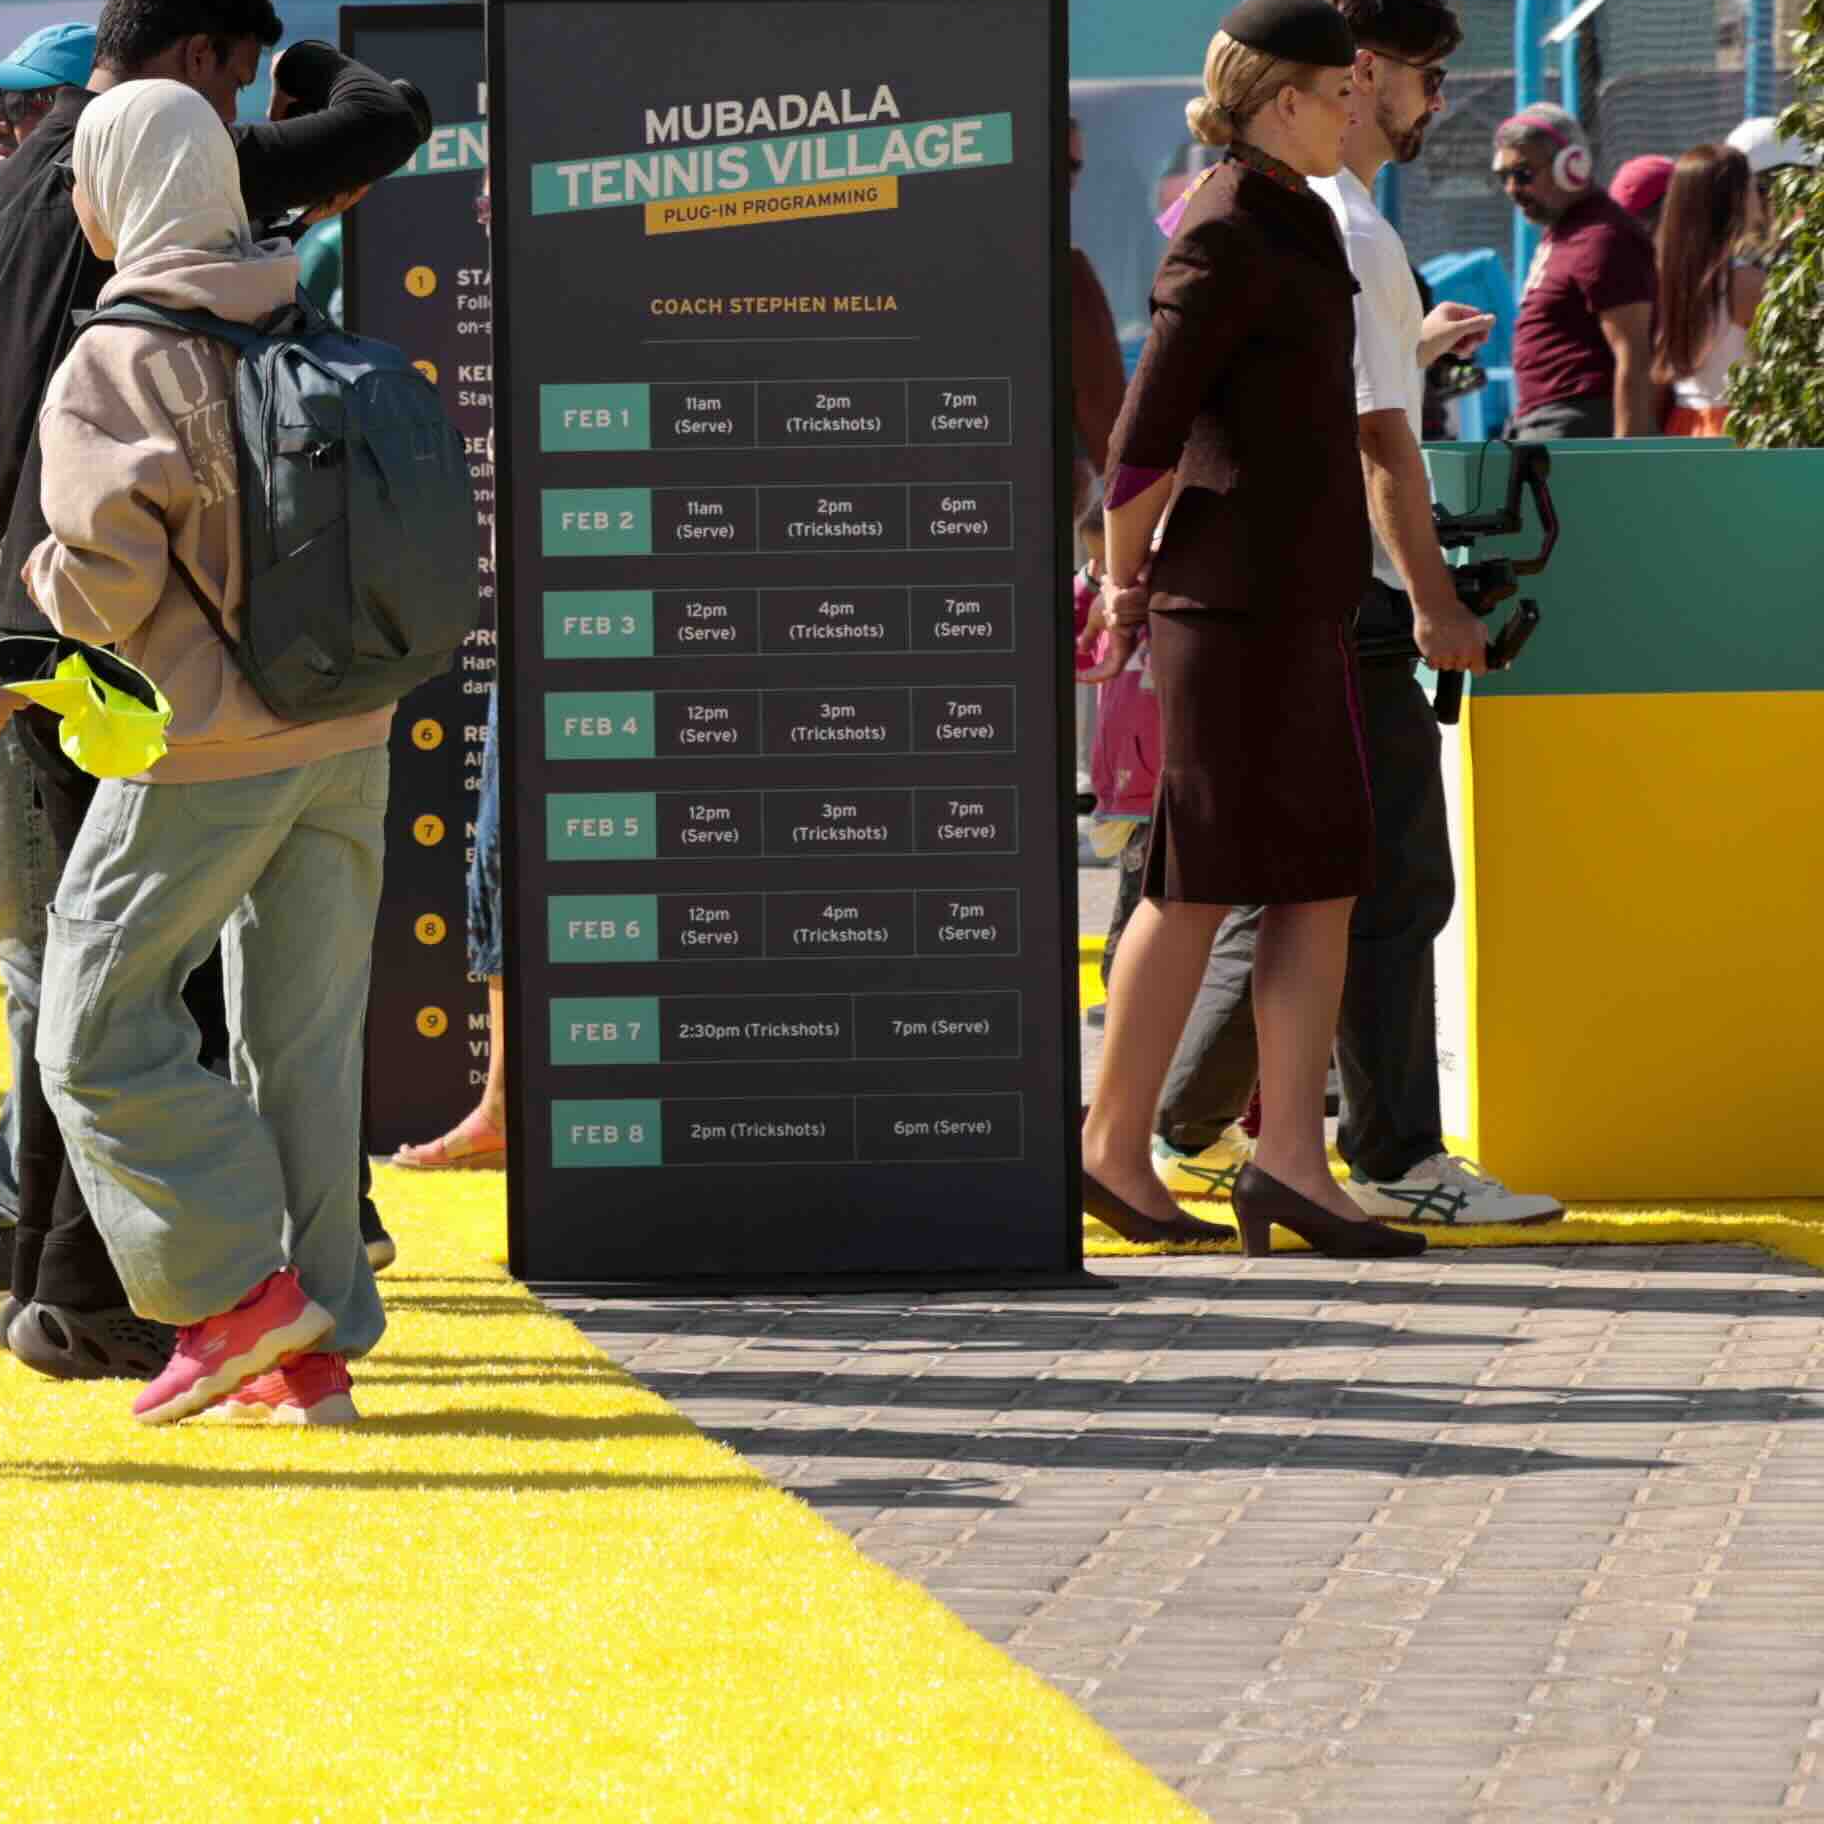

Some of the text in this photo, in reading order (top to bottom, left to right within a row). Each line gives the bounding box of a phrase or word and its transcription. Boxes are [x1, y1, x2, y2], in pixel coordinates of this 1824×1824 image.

[645, 84, 900, 145] MUBADALA
[557, 121, 984, 208] TENNIS VILLAGE
[663, 186, 879, 225] PLUG-IN PROGRAMMING
[651, 296, 896, 314] COACH STEPHEN MELIA
[686, 397, 721, 410] 11am
[816, 395, 850, 410] 2pm
[943, 393, 976, 408] 7pm
[565, 409, 628, 427] FEB 1
[787, 417, 880, 432] (Trickshots)
[932, 416, 989, 430] (Serve)
[675, 419, 732, 434] (Serve)
[688, 502, 722, 514] 11am
[818, 499, 852, 515] 2pm
[941, 497, 976, 513] 6pm
[563, 512, 633, 529] FEB 2
[930, 520, 988, 534] (Serve)
[677, 524, 734, 539] (Serve)
[788, 522, 882, 536] (Trickshots)
[686, 603, 727, 619] 12pm
[819, 602, 854, 616] 4pm
[946, 600, 980, 616] 7pm
[564, 616, 635, 634] FEB 3
[789, 624, 884, 639] (Trickshots)
[935, 622, 992, 637] (Serve)
[678, 626, 736, 640] (Serve)
[688, 706, 728, 722] 12pm
[821, 704, 855, 720] 3pm
[948, 702, 981, 717] 7pm
[565, 717, 638, 736] FEB 4
[791, 726, 885, 741] (Trickshots)
[937, 724, 994, 739] (Serve)
[421, 727, 432, 742] 6
[680, 729, 737, 744] (Serve)
[689, 806, 730, 822] 12pm
[823, 804, 856, 819] 3pm
[949, 801, 983, 816] 7pm
[567, 817, 638, 836] FEB 5
[793, 826, 887, 841] (Trickshots)
[938, 825, 995, 839] (Serve)
[682, 828, 738, 843] (Serve)
[689, 907, 729, 922] 12pm
[823, 906, 858, 920] 4pm
[949, 904, 984, 919] 7pm
[569, 921, 640, 938] FEB 6
[793, 928, 888, 944] (Trickshots)
[939, 926, 996, 940] (Serve)
[681, 931, 738, 944] (Serve)
[571, 1022, 640, 1040] FEB 7
[680, 1023, 839, 1040] 2:30pm (Trickshots)
[893, 1020, 989, 1036] 7pm (Serve)
[572, 1125, 643, 1144] FEB 8
[691, 1123, 825, 1140] 2pm (Trickshots)
[894, 1120, 991, 1136] 6pm (Serve)
